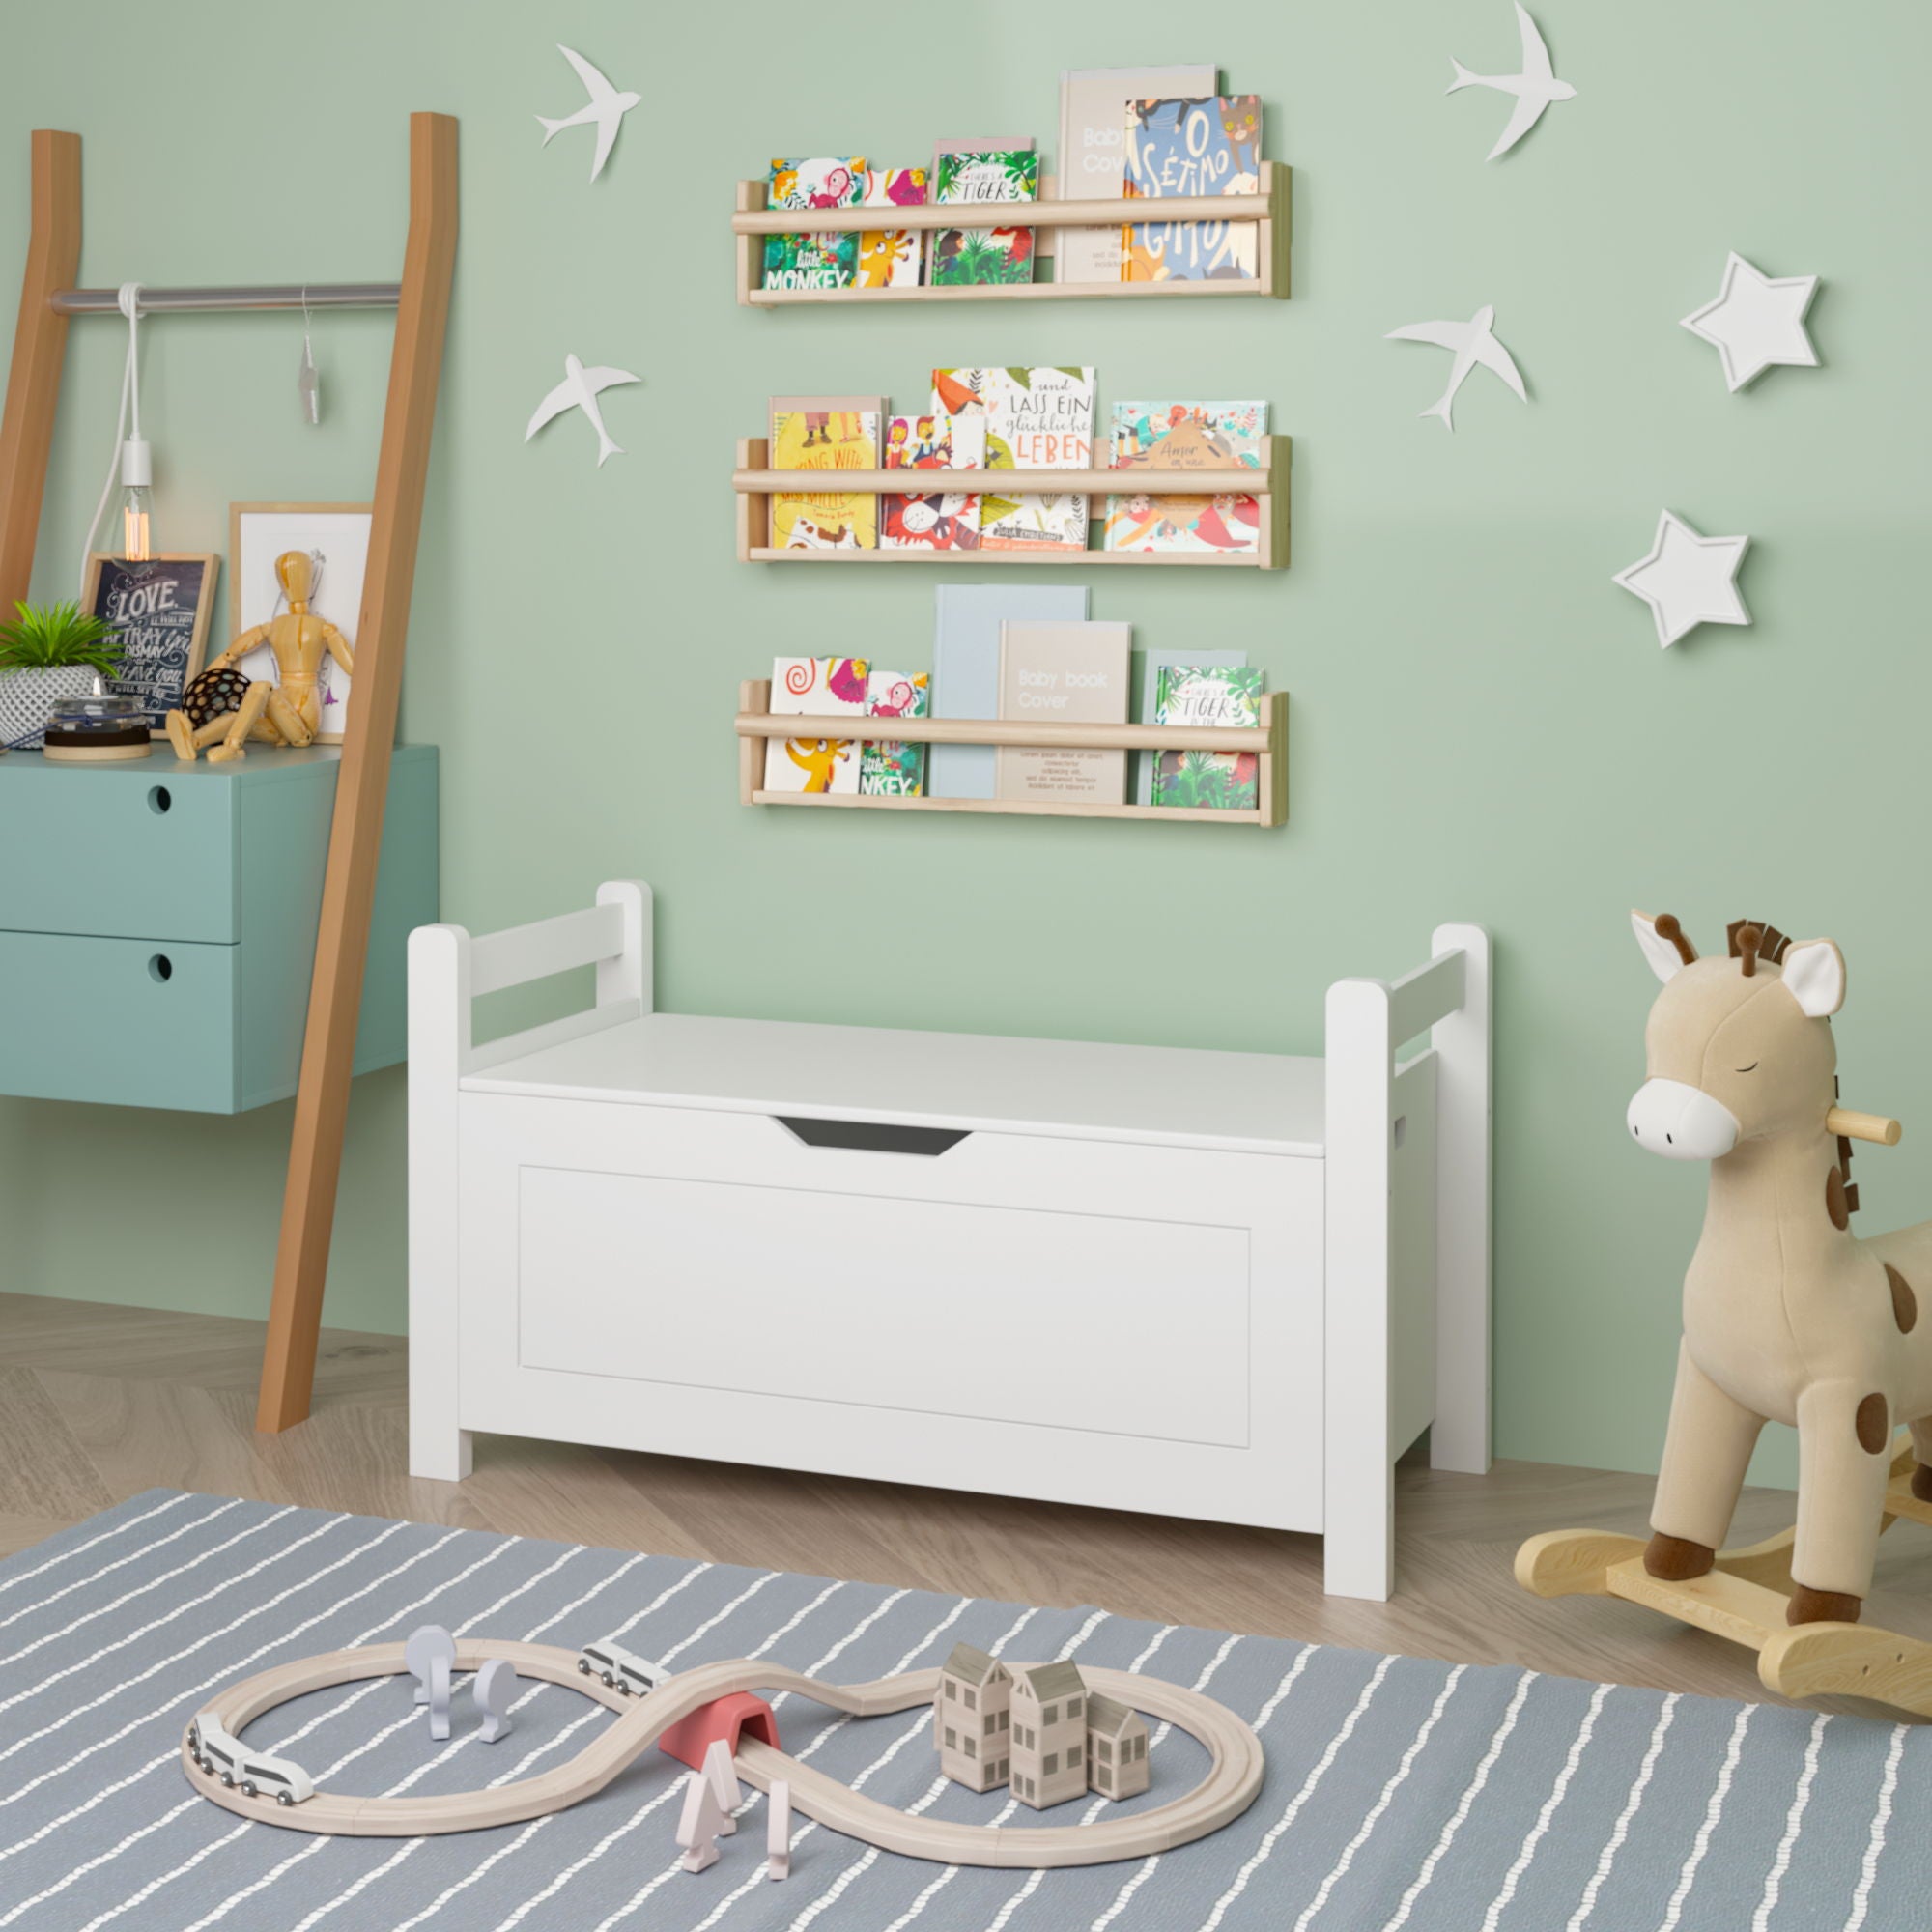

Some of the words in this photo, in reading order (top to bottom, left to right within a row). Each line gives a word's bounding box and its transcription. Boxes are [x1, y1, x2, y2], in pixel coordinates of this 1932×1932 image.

[1185, 109, 1210, 158] O
[962, 180, 1007, 201] TIGER
[766, 270, 850, 290] MONKEY
[1037, 378, 1071, 392] und
[1010, 393, 1046, 415] LASS
[1058, 394, 1092, 416] EIN
[1016, 433, 1092, 464] LEBEN
[124, 644, 164, 659] DISMAY
[1019, 668, 1059, 690] Baby
[1065, 670, 1108, 688] book
[1019, 691, 1069, 709] Cover
[1181, 696, 1231, 719] TIGER
